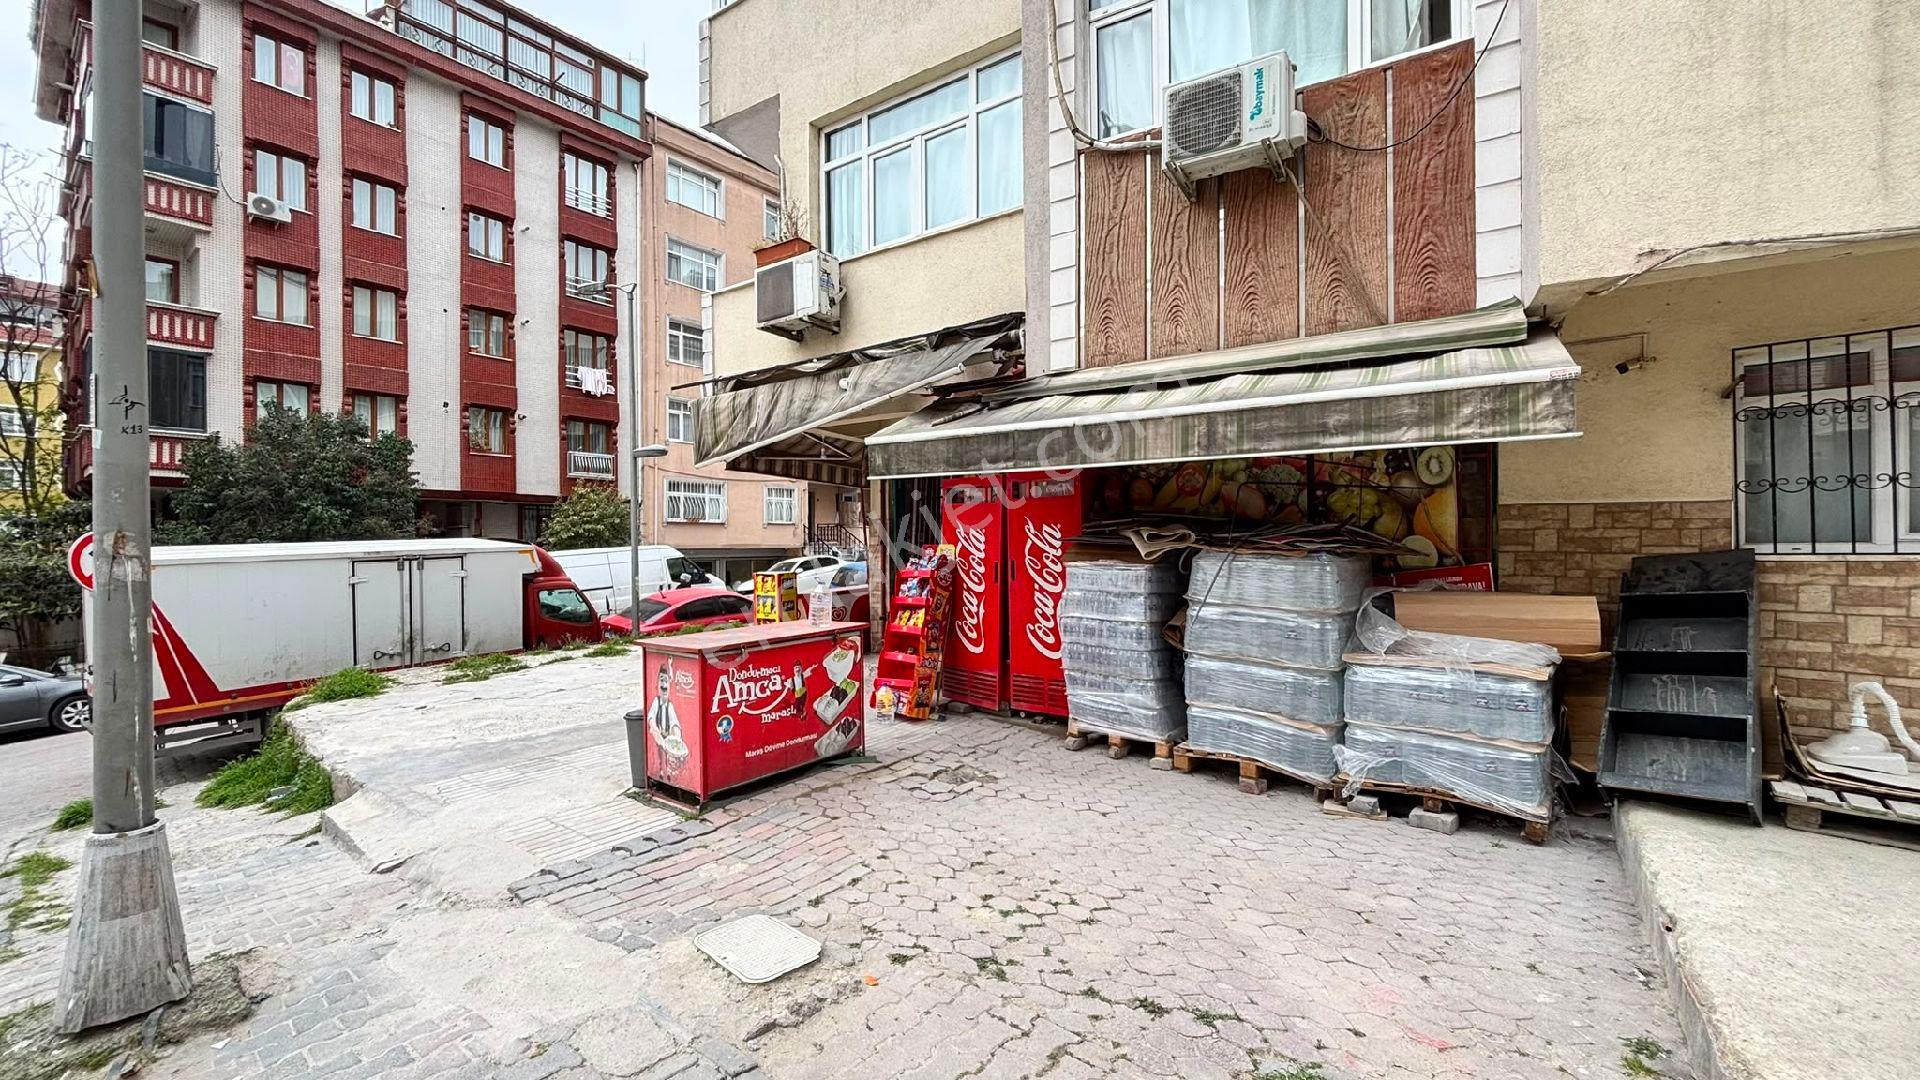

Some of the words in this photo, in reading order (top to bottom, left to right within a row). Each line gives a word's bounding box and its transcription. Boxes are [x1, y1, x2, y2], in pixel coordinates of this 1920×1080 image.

[1252, 67, 1265, 115] baymak
[955, 519, 986, 654] Coca-Cola
[1024, 516, 1062, 659] Coca-Cola
[710, 674, 782, 713] Amca
